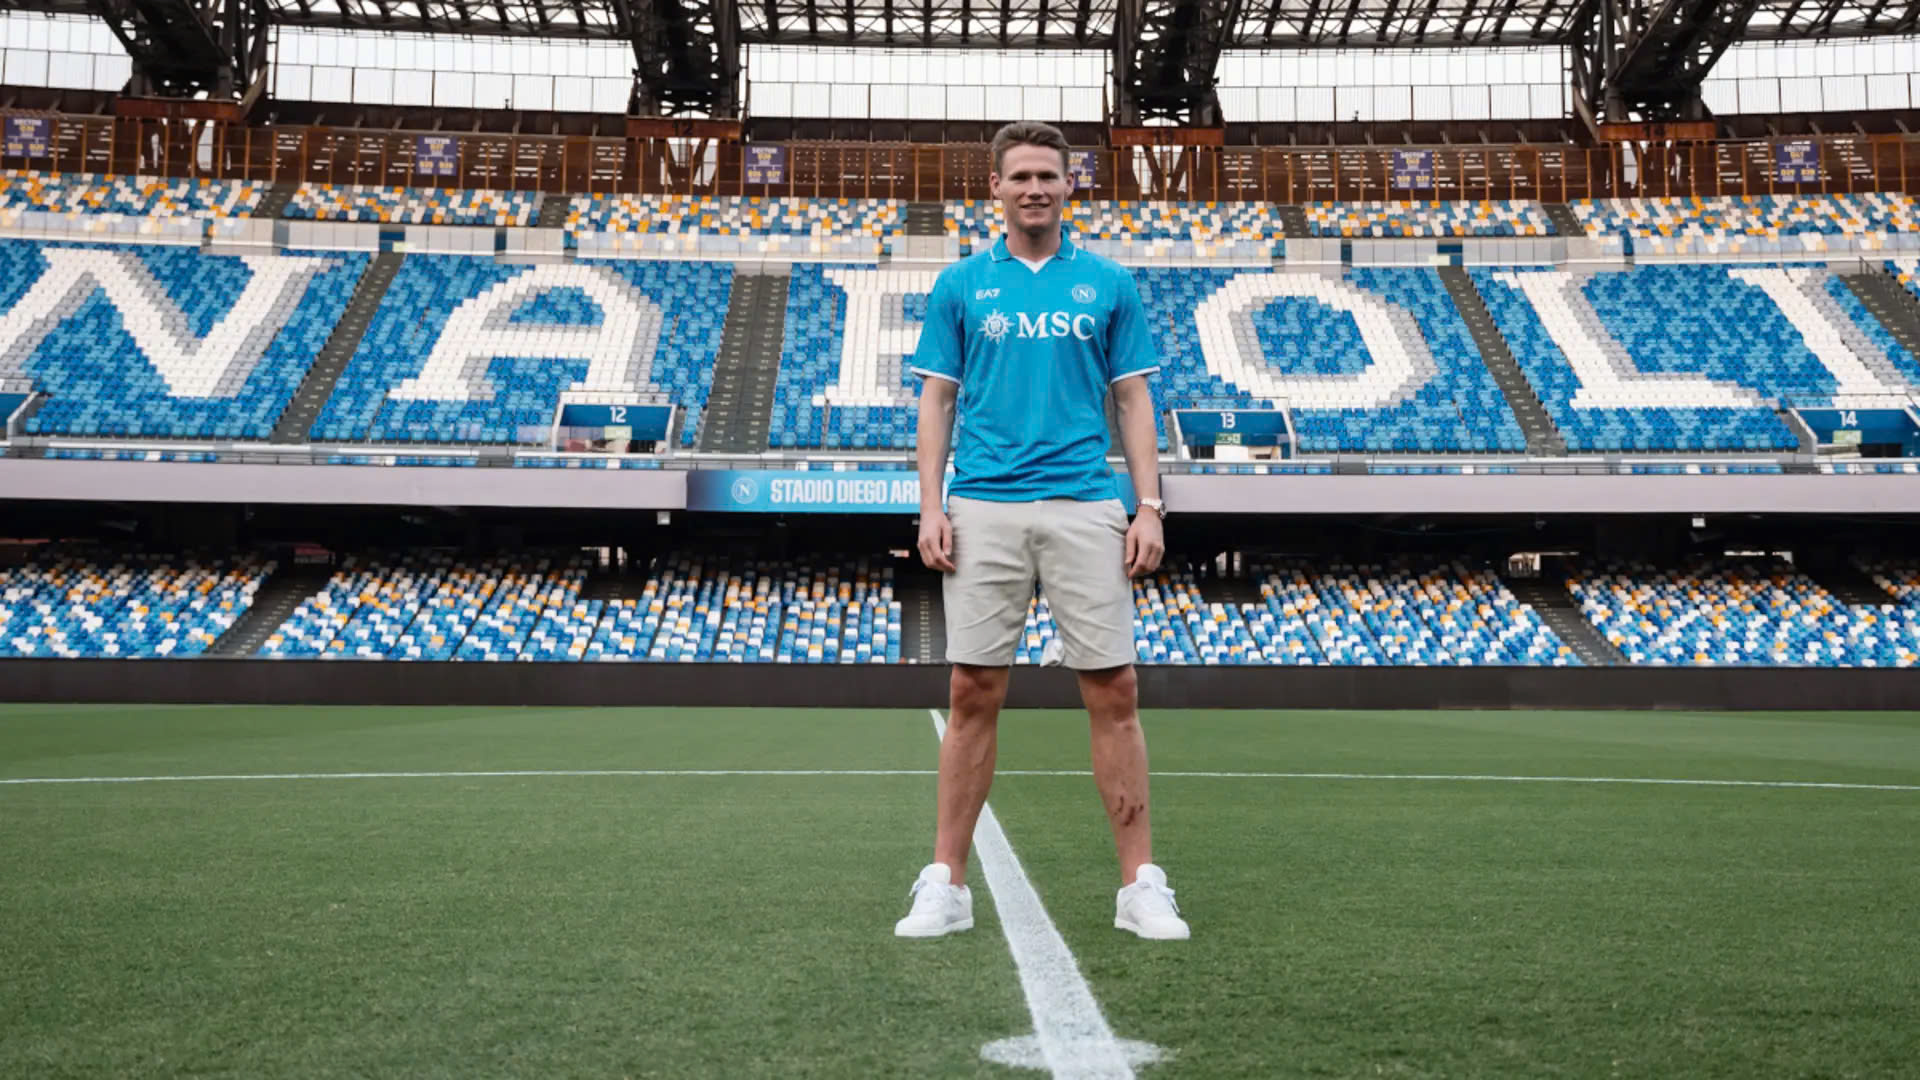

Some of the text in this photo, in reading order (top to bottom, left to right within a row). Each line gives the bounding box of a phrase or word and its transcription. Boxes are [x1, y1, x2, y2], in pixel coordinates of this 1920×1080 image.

[976, 288, 1000, 300] EA7
[1016, 311, 1095, 341] MSC
[610, 406, 626, 423] 12
[1220, 412, 1236, 429] 13
[1839, 411, 1858, 427] 14
[770, 479, 834, 504] STADIO
[837, 479, 887, 504] DIEGO
